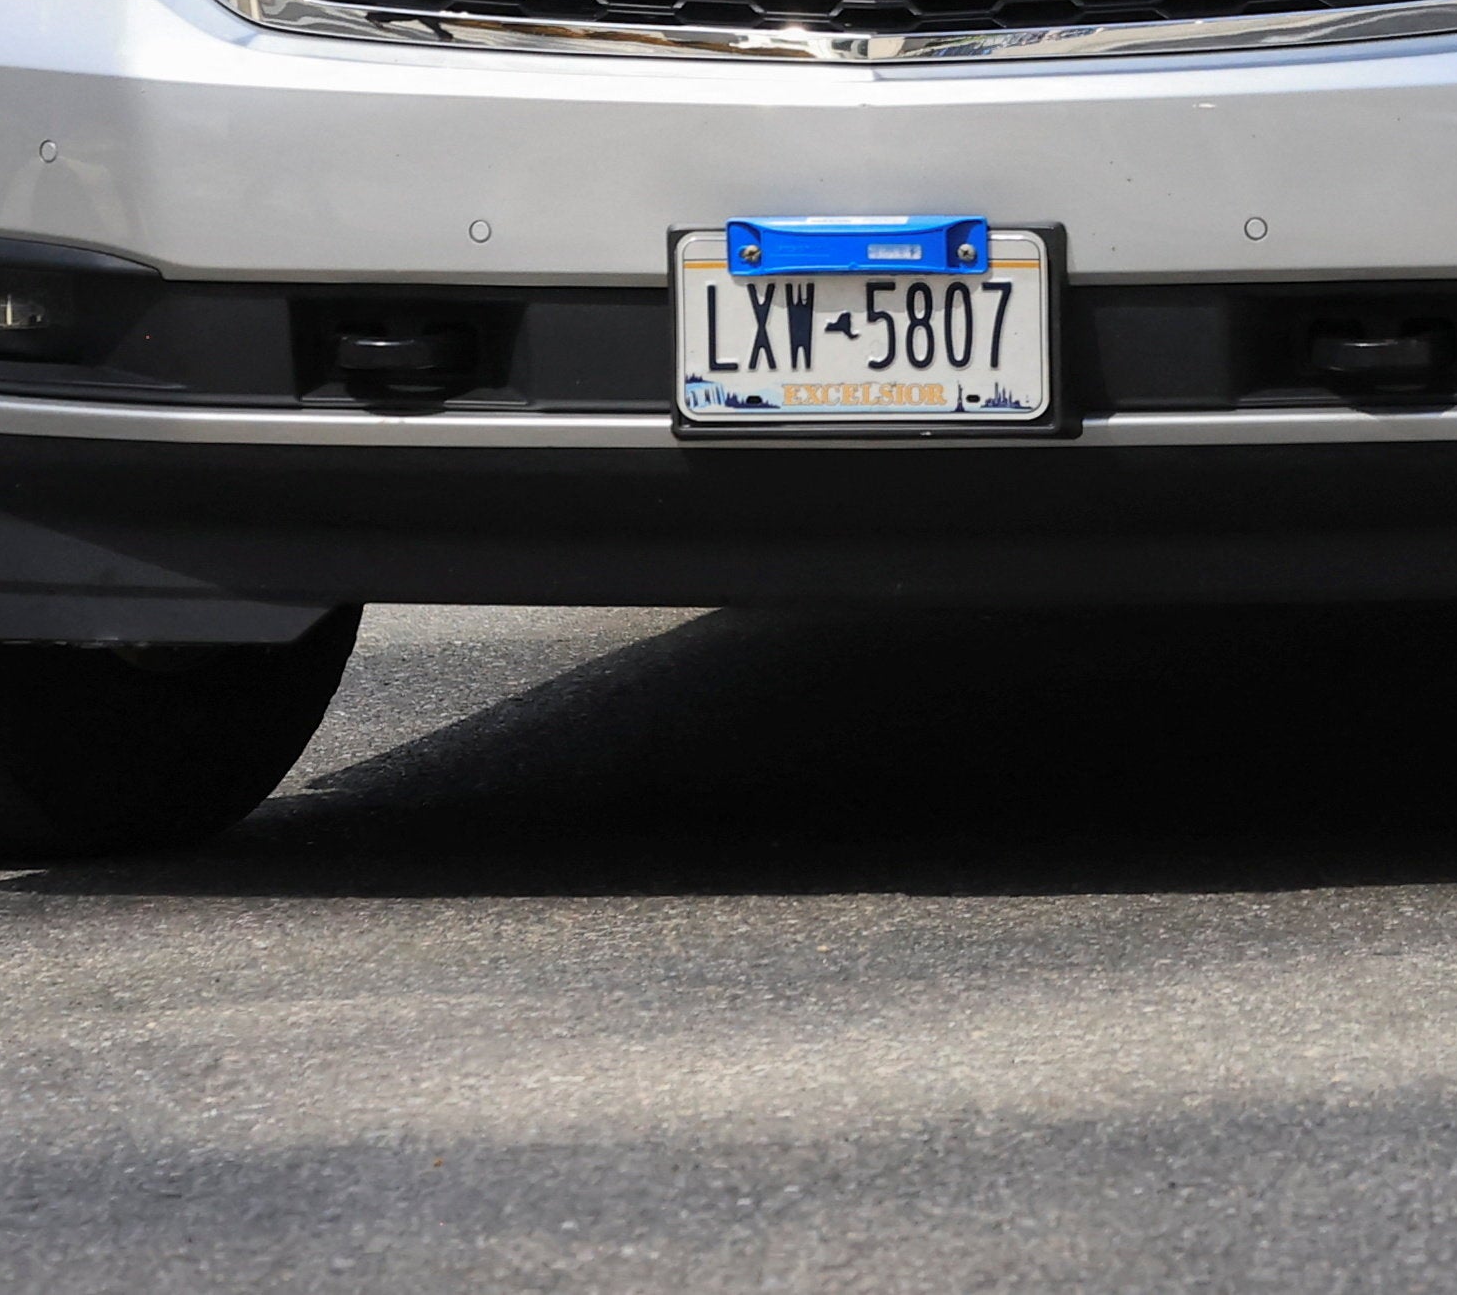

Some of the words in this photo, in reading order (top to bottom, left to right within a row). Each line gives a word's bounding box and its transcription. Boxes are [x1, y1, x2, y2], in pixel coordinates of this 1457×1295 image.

[706, 282, 815, 371] LXW
[865, 281, 1013, 370] 5807
[781, 382, 947, 407] EXCELSIOR
